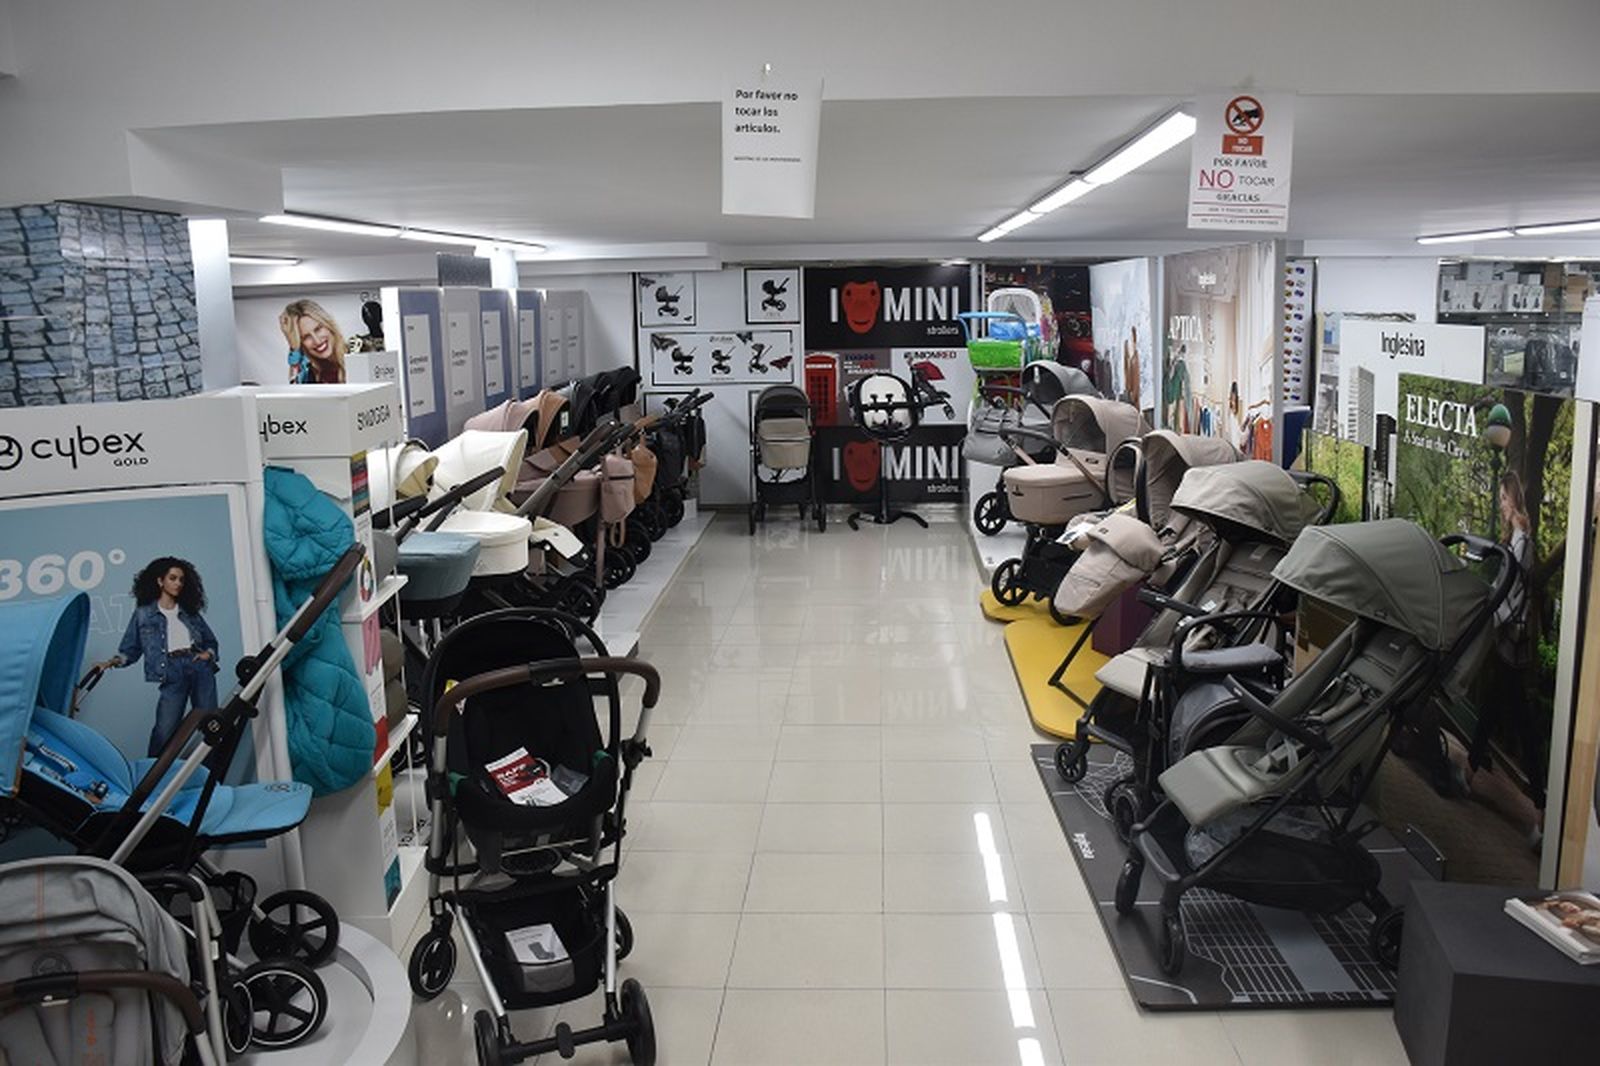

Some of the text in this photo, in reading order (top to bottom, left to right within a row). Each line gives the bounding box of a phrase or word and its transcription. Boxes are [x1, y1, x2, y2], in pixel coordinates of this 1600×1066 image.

[735, 89, 798, 101] Por favor no
[735, 105, 778, 117] tocar los
[1213, 157, 1233, 167] POR
[1199, 169, 1275, 189] NO TOCAR
[1216, 193, 1260, 202] GRACIAS
[830, 285, 959, 322] I MINI
[1381, 331, 1425, 359] Inglesina
[259, 413, 308, 442] ybex
[1405, 393, 1479, 438] ELECTA
[31, 424, 146, 470] cybex
[113, 457, 149, 467] GOLD
[832, 445, 959, 481] I MINI
